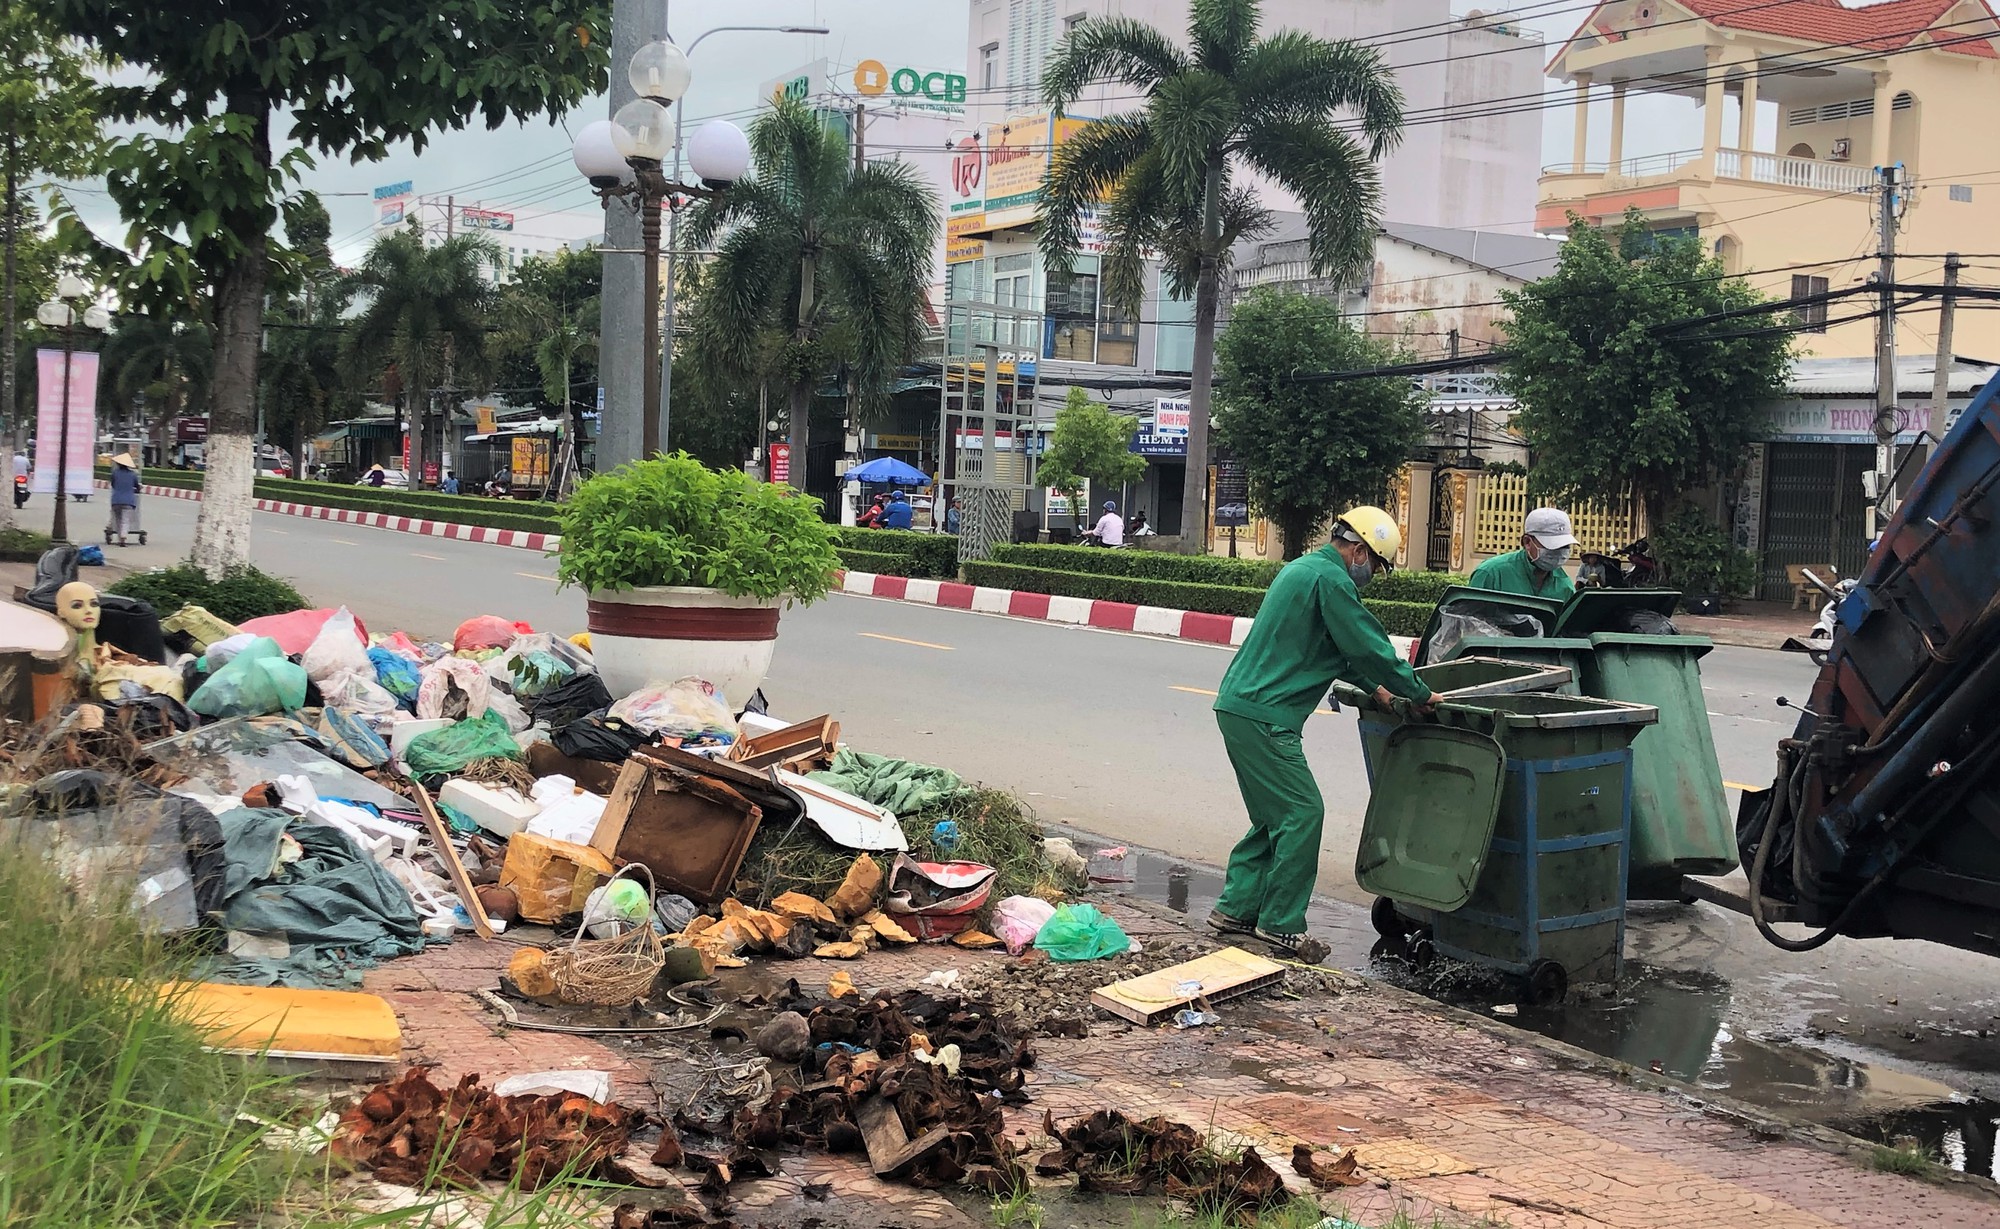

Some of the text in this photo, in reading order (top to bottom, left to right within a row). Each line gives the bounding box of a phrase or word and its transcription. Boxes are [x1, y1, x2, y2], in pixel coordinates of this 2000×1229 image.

[784, 76, 809, 101] OCB
[891, 68, 966, 104] OCB
[464, 217, 492, 229] BANK
[1160, 401, 1174, 411] NHÀ
[1830, 408, 1874, 431] PHON
